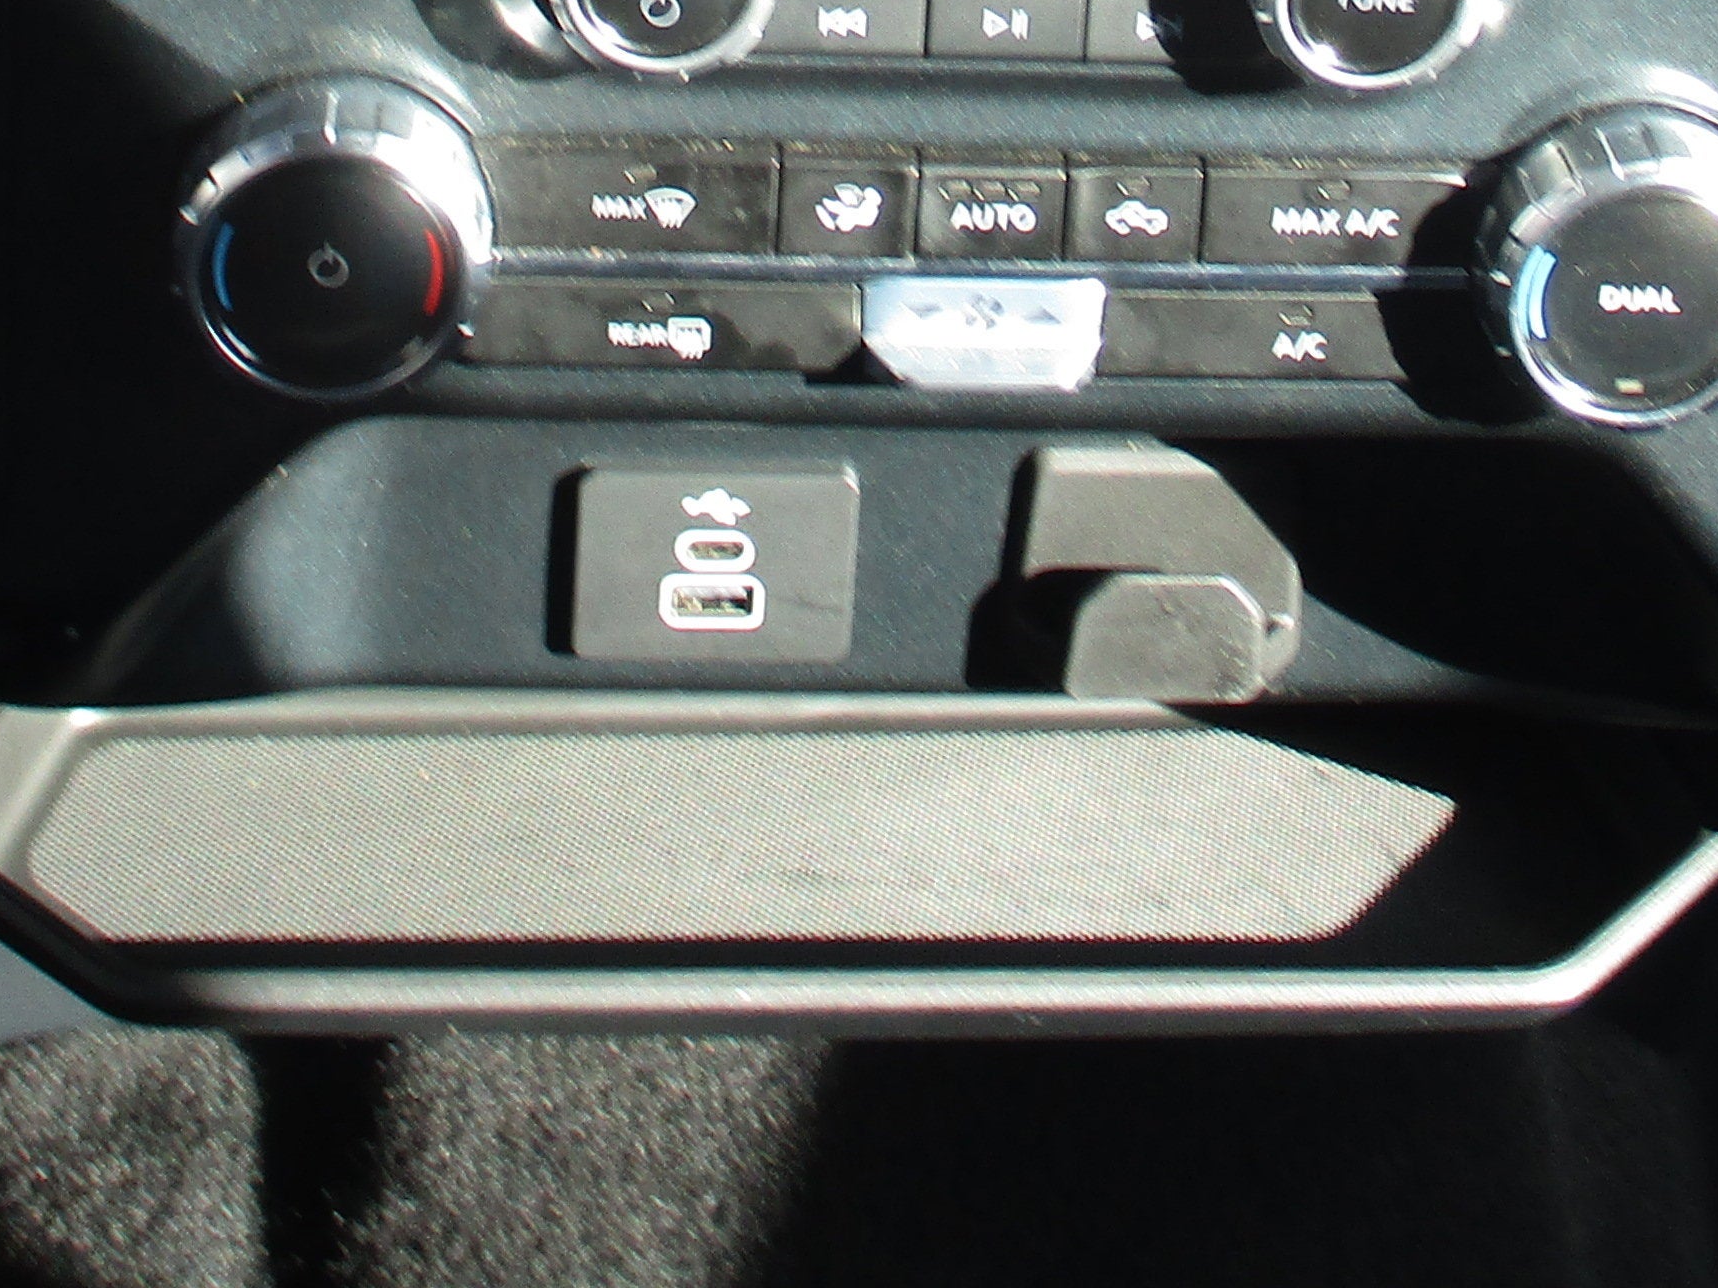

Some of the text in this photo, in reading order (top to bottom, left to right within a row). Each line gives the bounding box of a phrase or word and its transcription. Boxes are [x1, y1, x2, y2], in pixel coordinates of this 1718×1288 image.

[949, 202, 1037, 232] AUTO
[1271, 206, 1400, 239] MAX A/C
[1598, 283, 1683, 314] DUAL
[1271, 331, 1329, 361] A/C
